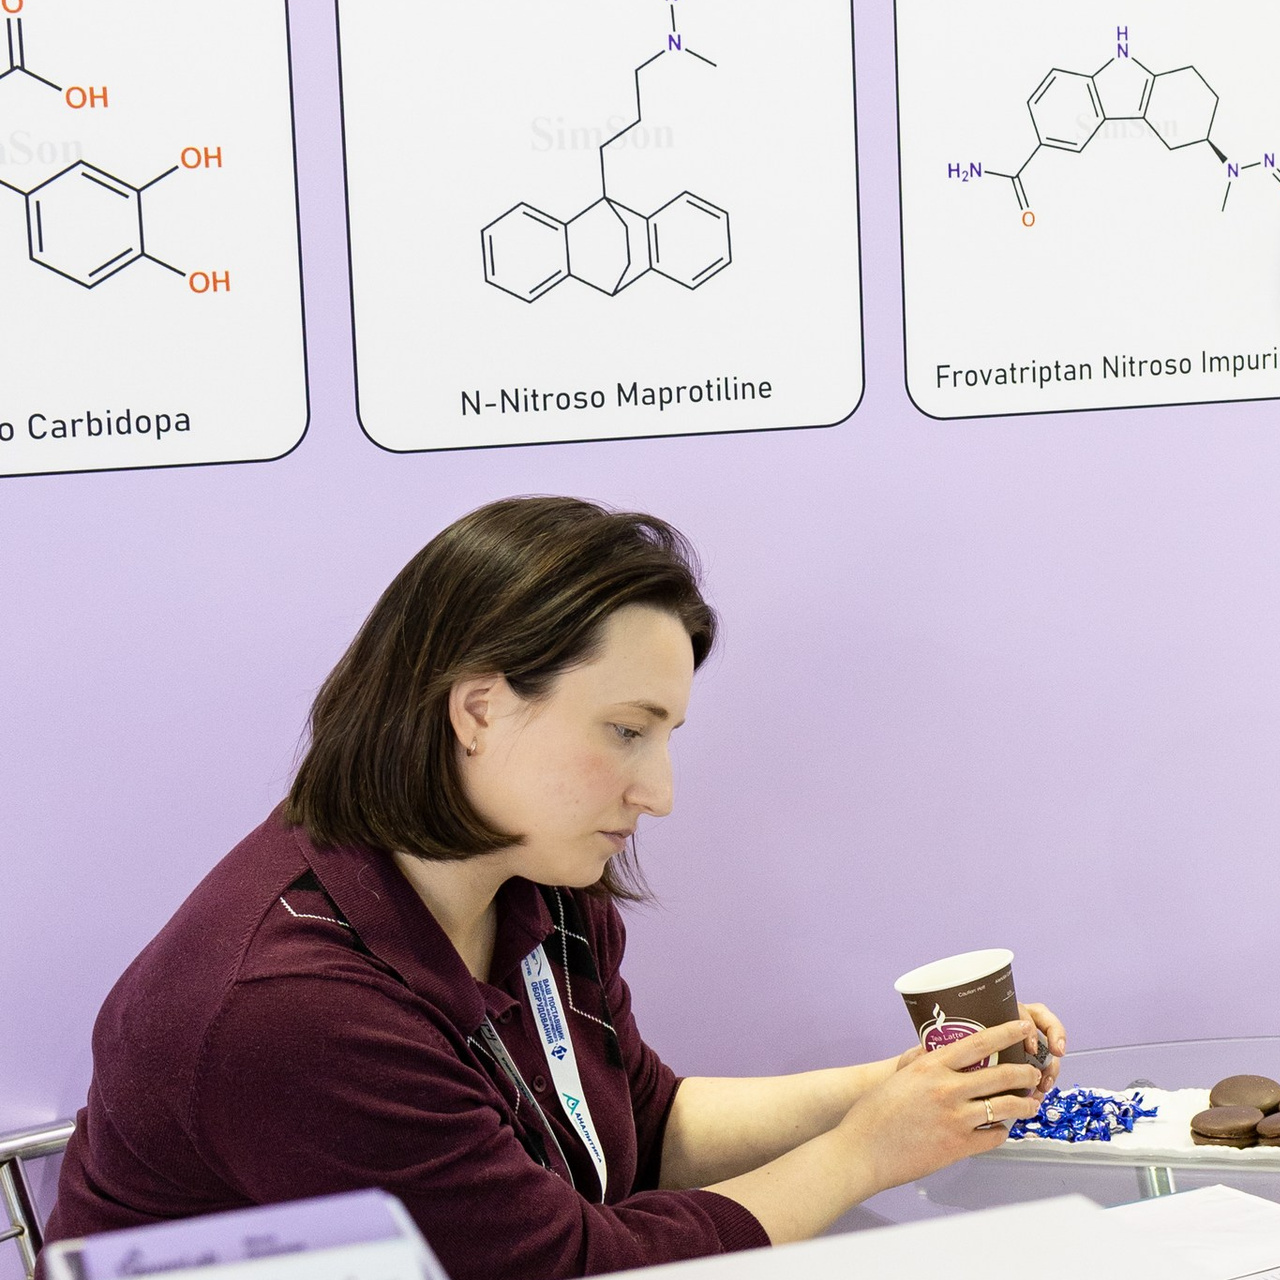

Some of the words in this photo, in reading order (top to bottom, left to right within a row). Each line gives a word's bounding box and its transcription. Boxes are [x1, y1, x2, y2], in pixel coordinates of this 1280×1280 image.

[668, 34, 681, 51] N
[1117, 26, 1128, 40] H
[1118, 43, 1128, 58] N
[65, 86, 108, 109] OH
[0, 129, 83, 166] Son
[180, 146, 222, 169] OH
[1228, 163, 1238, 176] N
[1264, 153, 1274, 167] N
[1022, 211, 1035, 227] O
[189, 270, 230, 293] OH
[937, 361, 1091, 389] Frovatriptan
[1103, 356, 1191, 378] Nitroso
[462, 388, 604, 415] N-Nitroso
[618, 377, 771, 411] Maprotiline
[29, 409, 190, 440] Carbidopa
[530, 981, 554, 1045] ОБОРУДОВАНИЯ
[575, 1112, 602, 1163] АНАЛИТИКА
